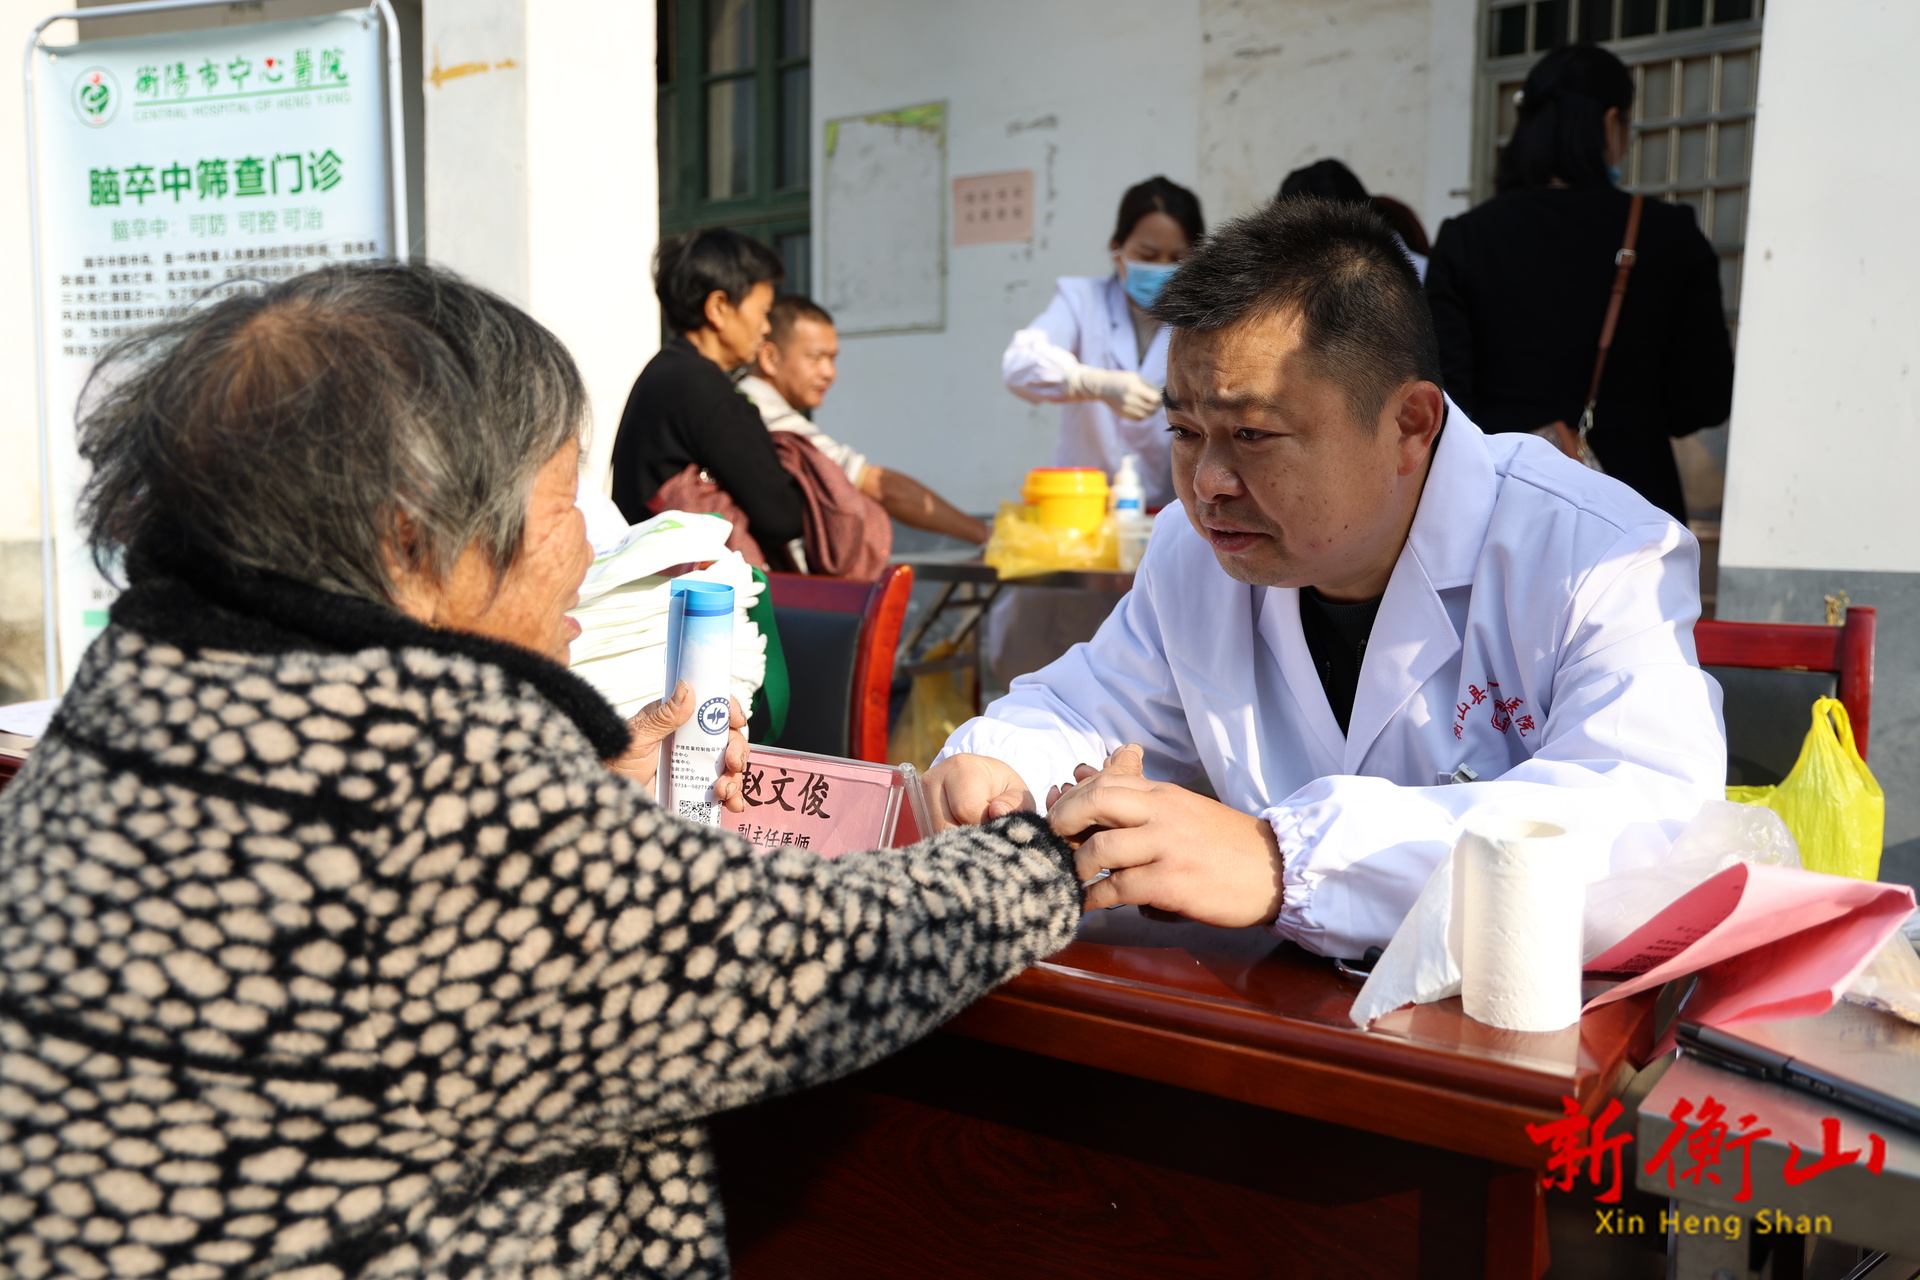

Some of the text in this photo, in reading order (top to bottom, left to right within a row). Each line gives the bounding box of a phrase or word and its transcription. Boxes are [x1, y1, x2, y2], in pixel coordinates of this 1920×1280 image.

[134, 90, 352, 122] CENTRAL HOSPITAL OF HENG YANG
[89, 148, 343, 208] 脑卒中筛查门诊
[189, 212, 227, 238] 可防
[238, 208, 277, 235] 可控
[282, 205, 324, 232] 可治
[741, 762, 831, 819] 赵文俊
[737, 822, 811, 850] 副主任医师
